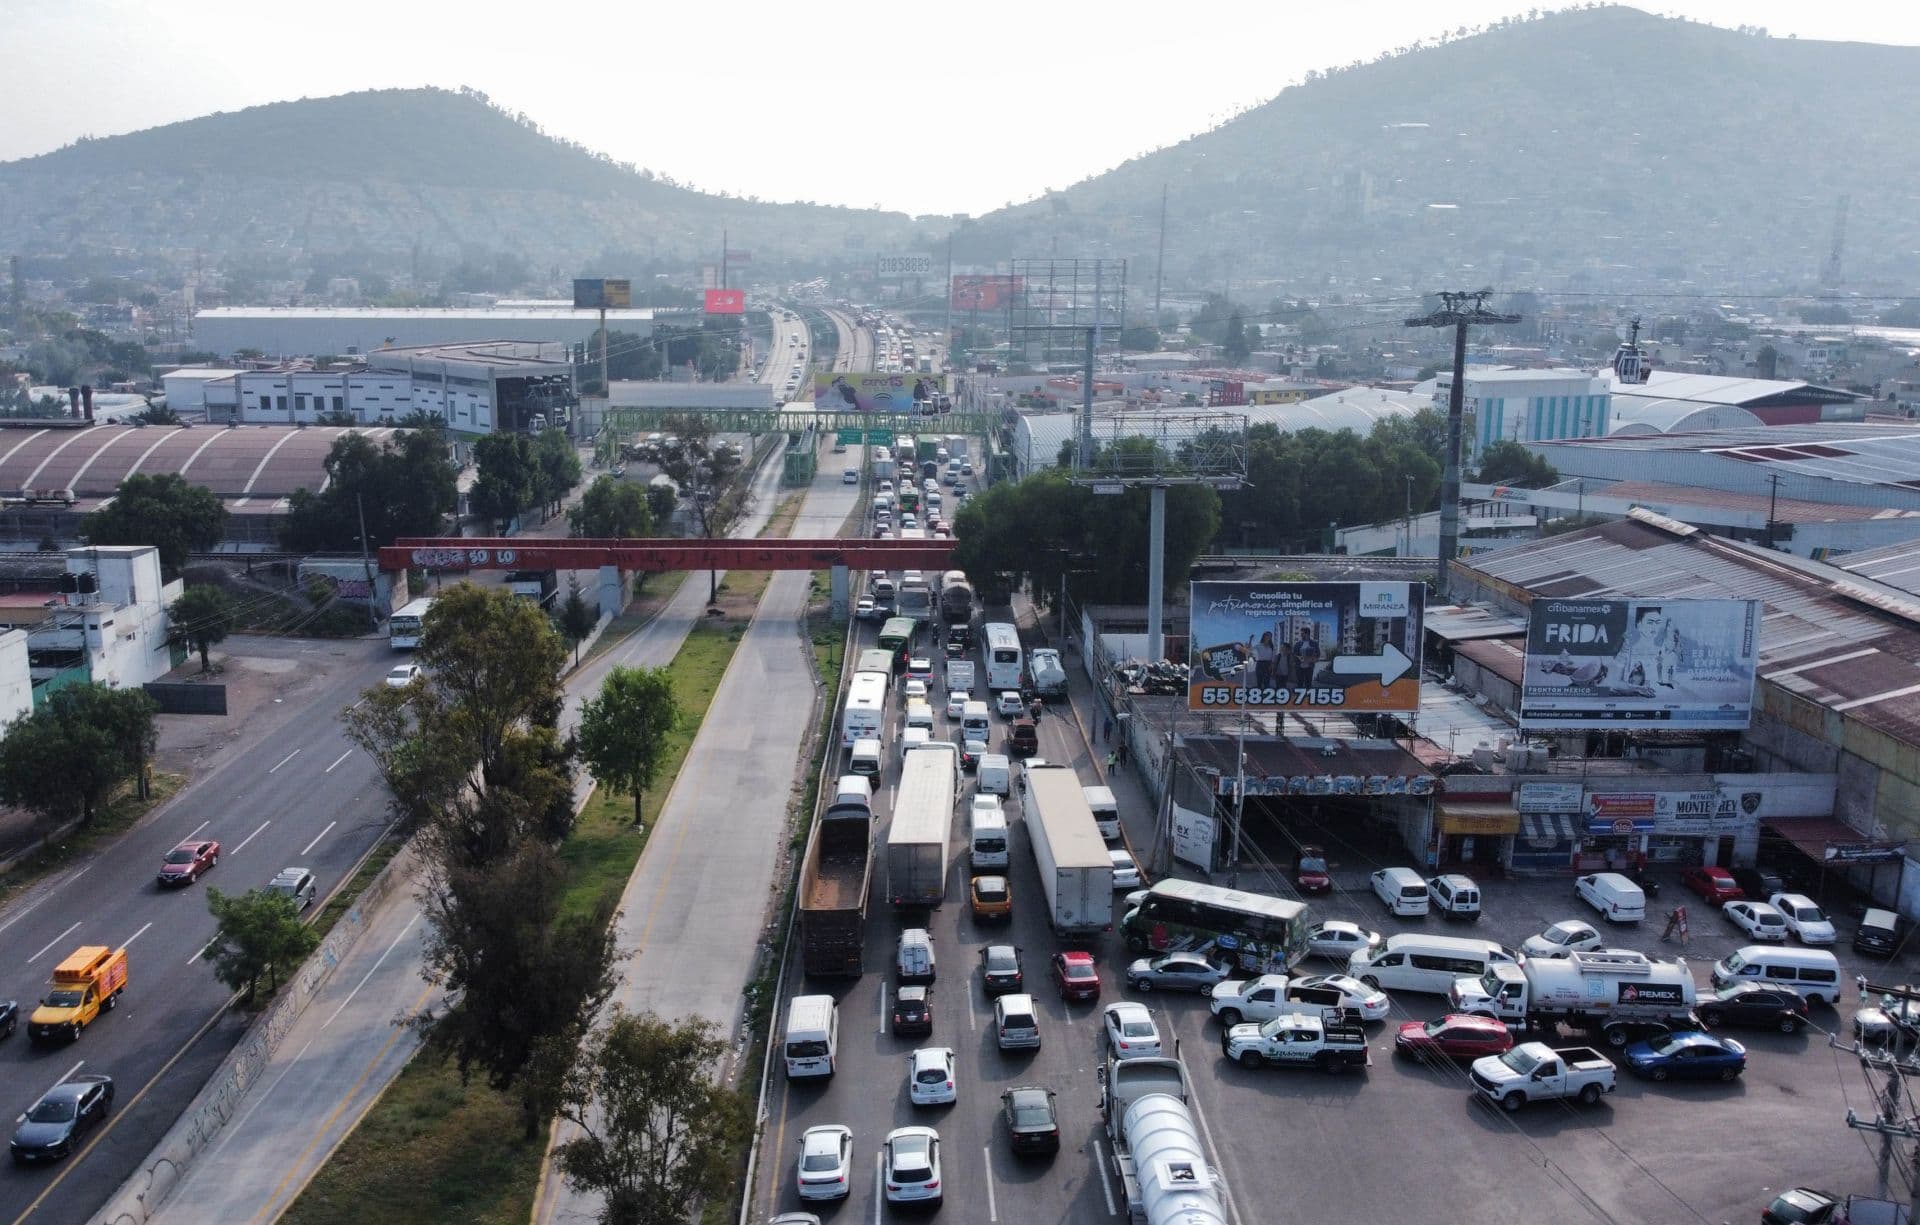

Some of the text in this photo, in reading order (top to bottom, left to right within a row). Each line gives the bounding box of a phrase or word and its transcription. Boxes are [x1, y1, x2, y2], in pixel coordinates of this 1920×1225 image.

[1249, 591, 1303, 600] Consolida tu
[1282, 600, 1323, 609] simplifica
[1324, 600, 1333, 608] el
[1547, 602, 1602, 613] citibanamex
[1245, 609, 1276, 617] regreso
[1545, 623, 1609, 643] FRIDA
[1202, 688, 1230, 704] 55
[1233, 688, 1290, 704] 5829
[1294, 688, 1344, 704] 7155
[1639, 990, 1676, 999] PEMEX
